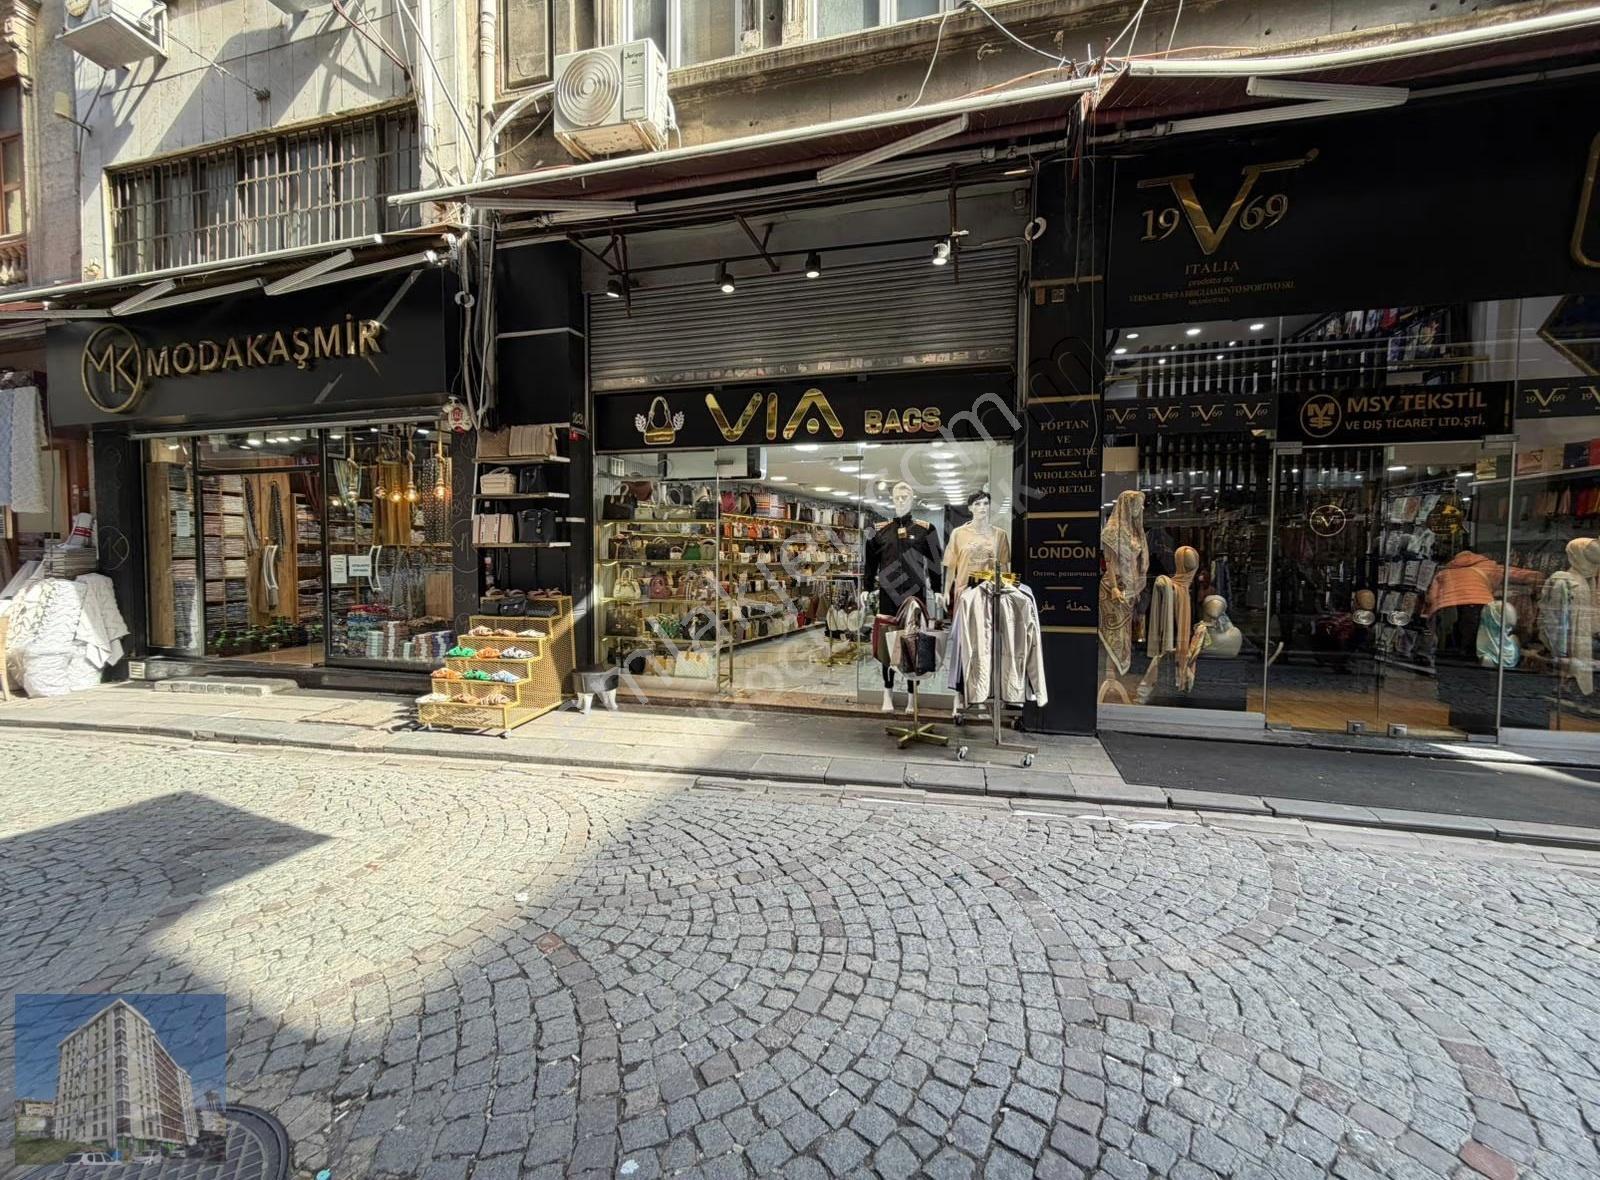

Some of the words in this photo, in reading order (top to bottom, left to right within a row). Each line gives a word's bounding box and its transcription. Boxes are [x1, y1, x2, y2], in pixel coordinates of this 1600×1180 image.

[1185, 261, 1240, 275] ITALIA
[146, 313, 382, 377] MODAKAŞMİR
[1347, 395, 1395, 413] MSY
[1400, 388, 1487, 411] TEKSTİL
[705, 388, 844, 442] VIA
[864, 407, 942, 435] BAGS
[1040, 420, 1089, 431] TOPTAN
[1345, 420, 1360, 430] VE
[1386, 416, 1435, 429] TİCARET
[1057, 435, 1072, 444] VE
[1030, 448, 1097, 458] PERAKENDE
[1034, 470, 1096, 480] WHOLESALE
[1036, 485, 1056, 494] AND
[1058, 485, 1095, 493] RETAIL
[1057, 524, 1068, 537] Y
[1029, 546, 1096, 559] LONDON
